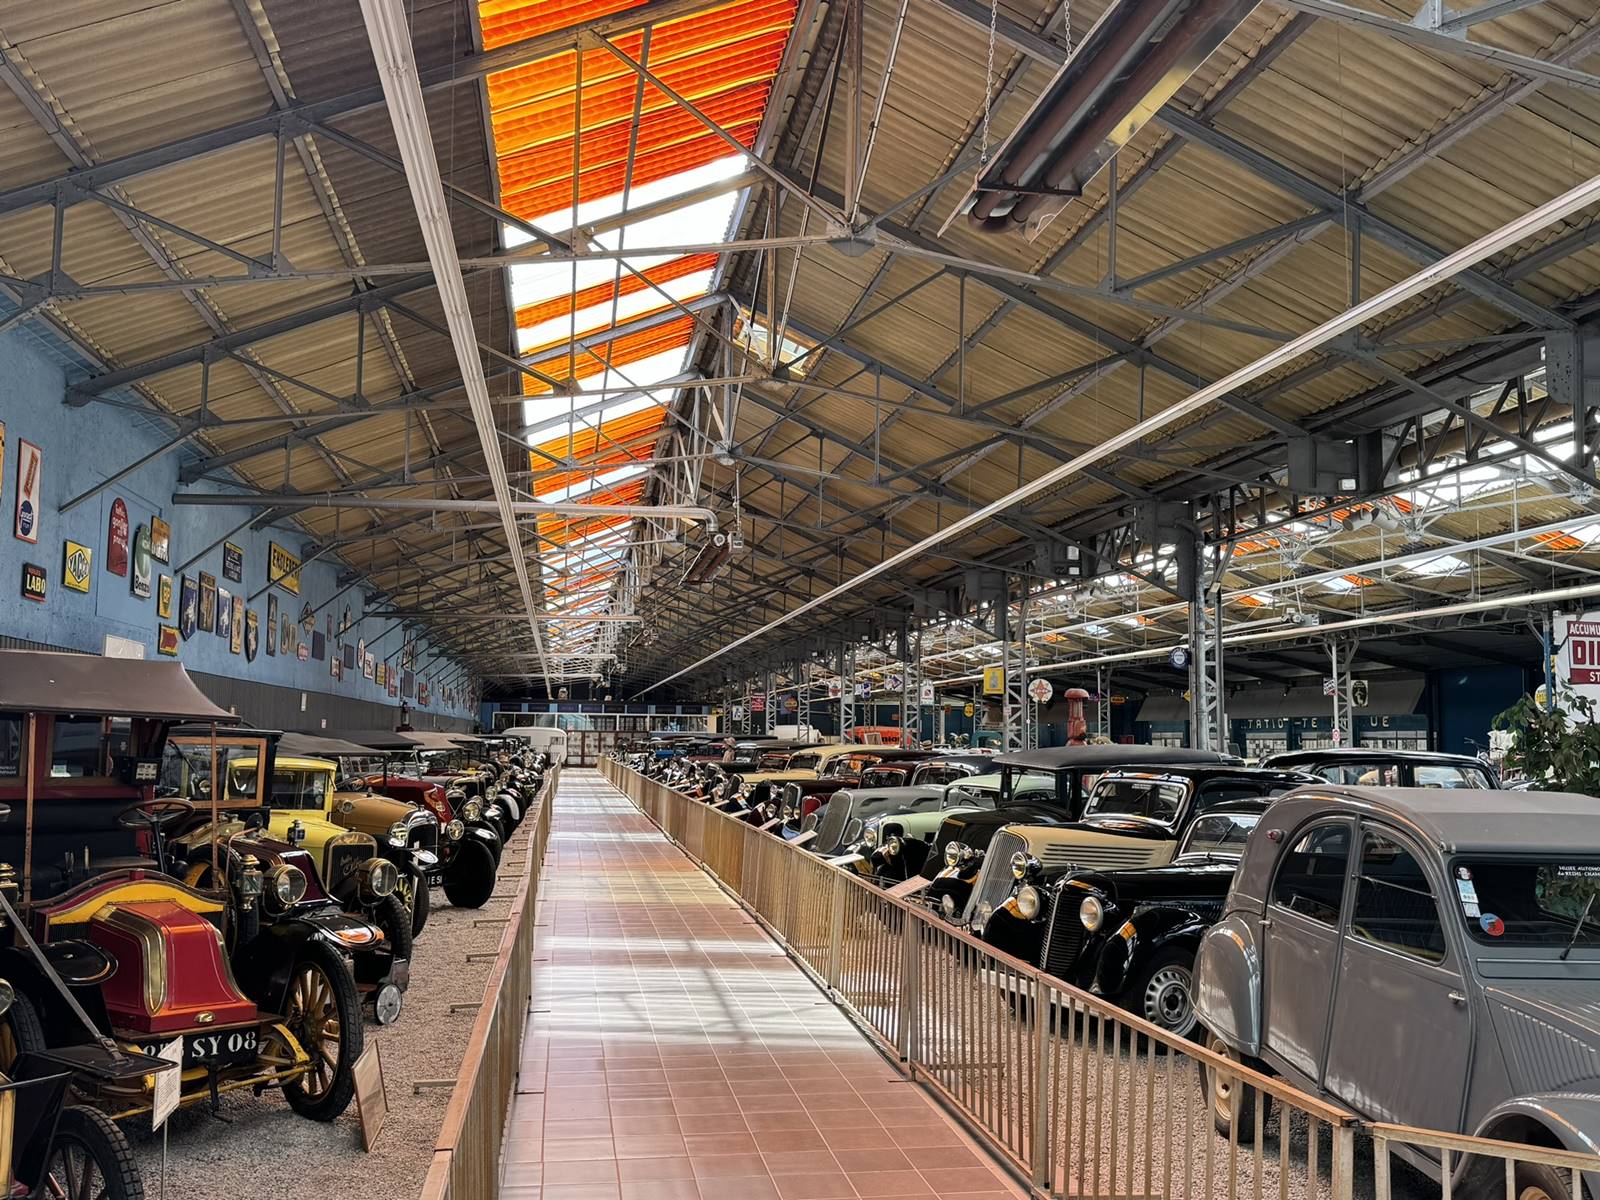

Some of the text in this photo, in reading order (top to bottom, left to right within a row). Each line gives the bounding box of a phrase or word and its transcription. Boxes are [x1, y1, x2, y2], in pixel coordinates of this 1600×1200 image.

[26, 574, 46, 594] LABO
[191, 1035, 222, 1058] SY
[227, 1031, 257, 1053] 08
